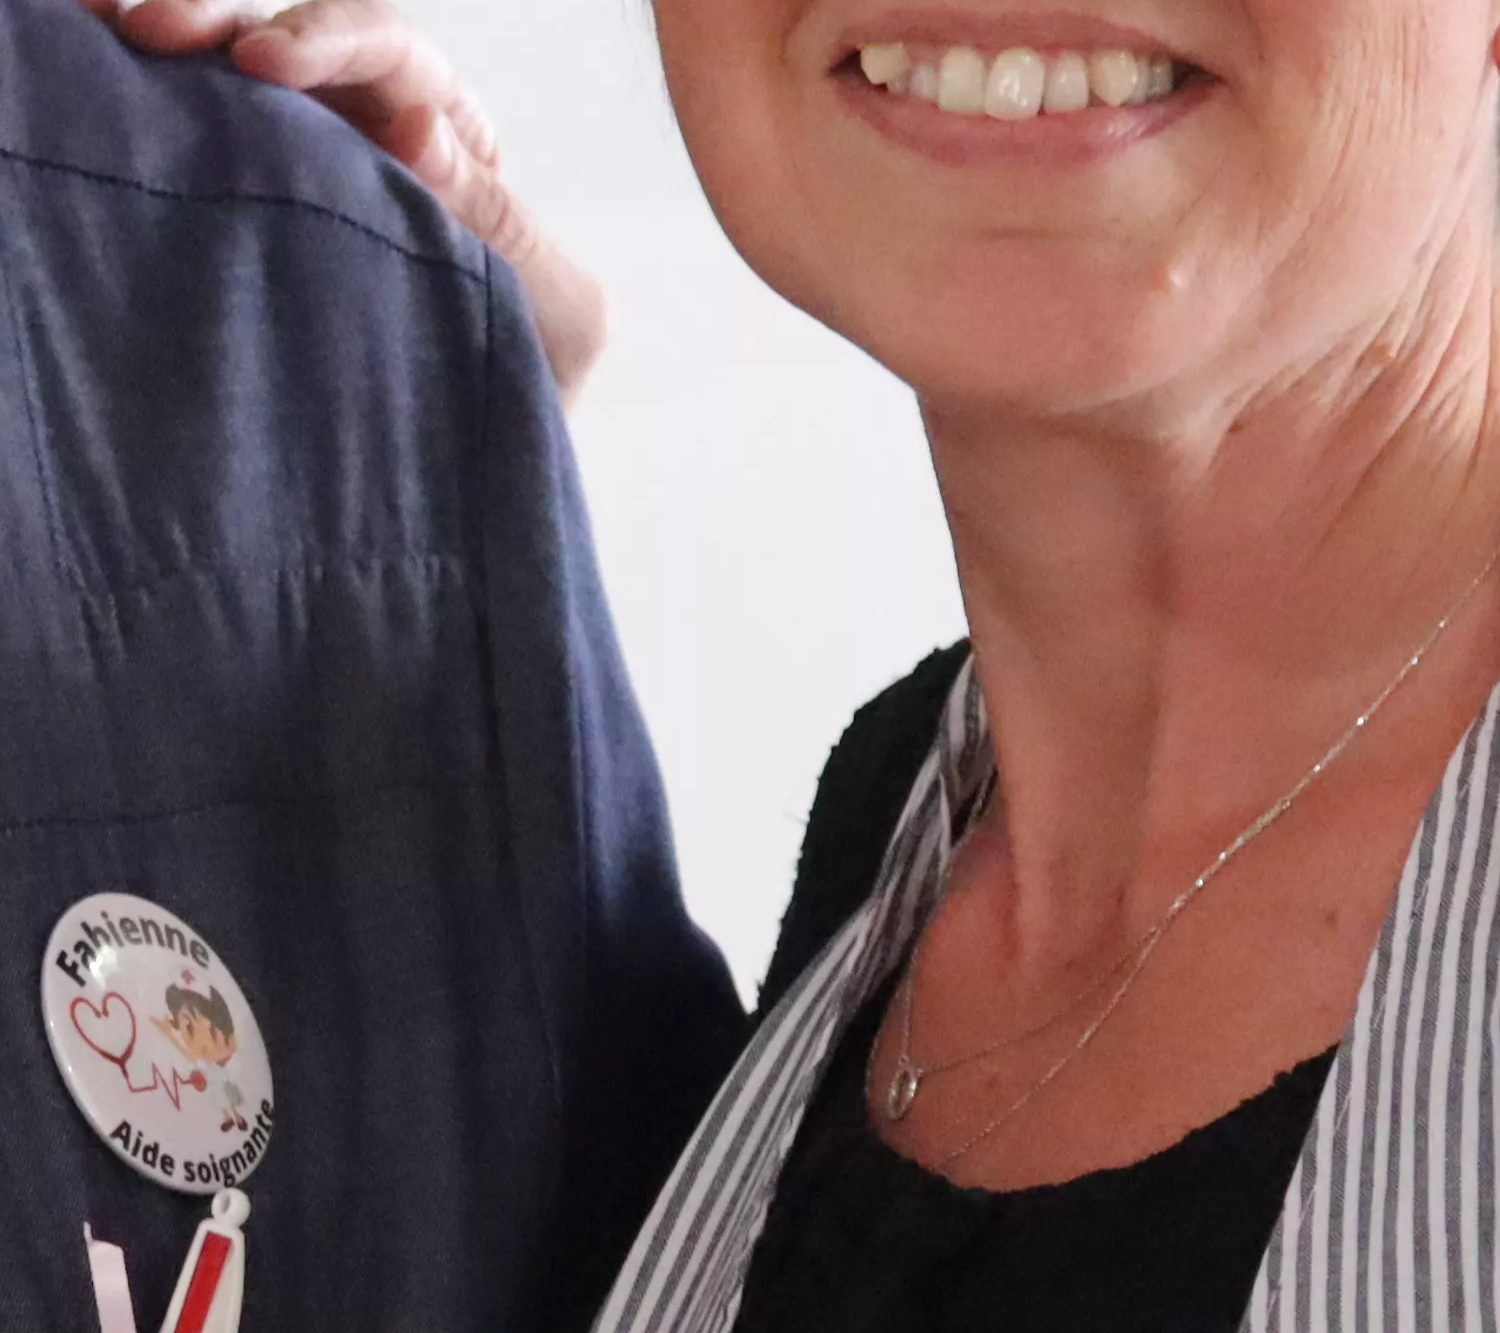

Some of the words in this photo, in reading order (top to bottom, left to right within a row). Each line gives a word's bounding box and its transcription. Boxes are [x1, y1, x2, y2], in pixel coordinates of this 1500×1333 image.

[56, 910, 210, 988] Fabienne
[110, 1120, 175, 1177] Aide
[183, 1098, 275, 1188] soignante
